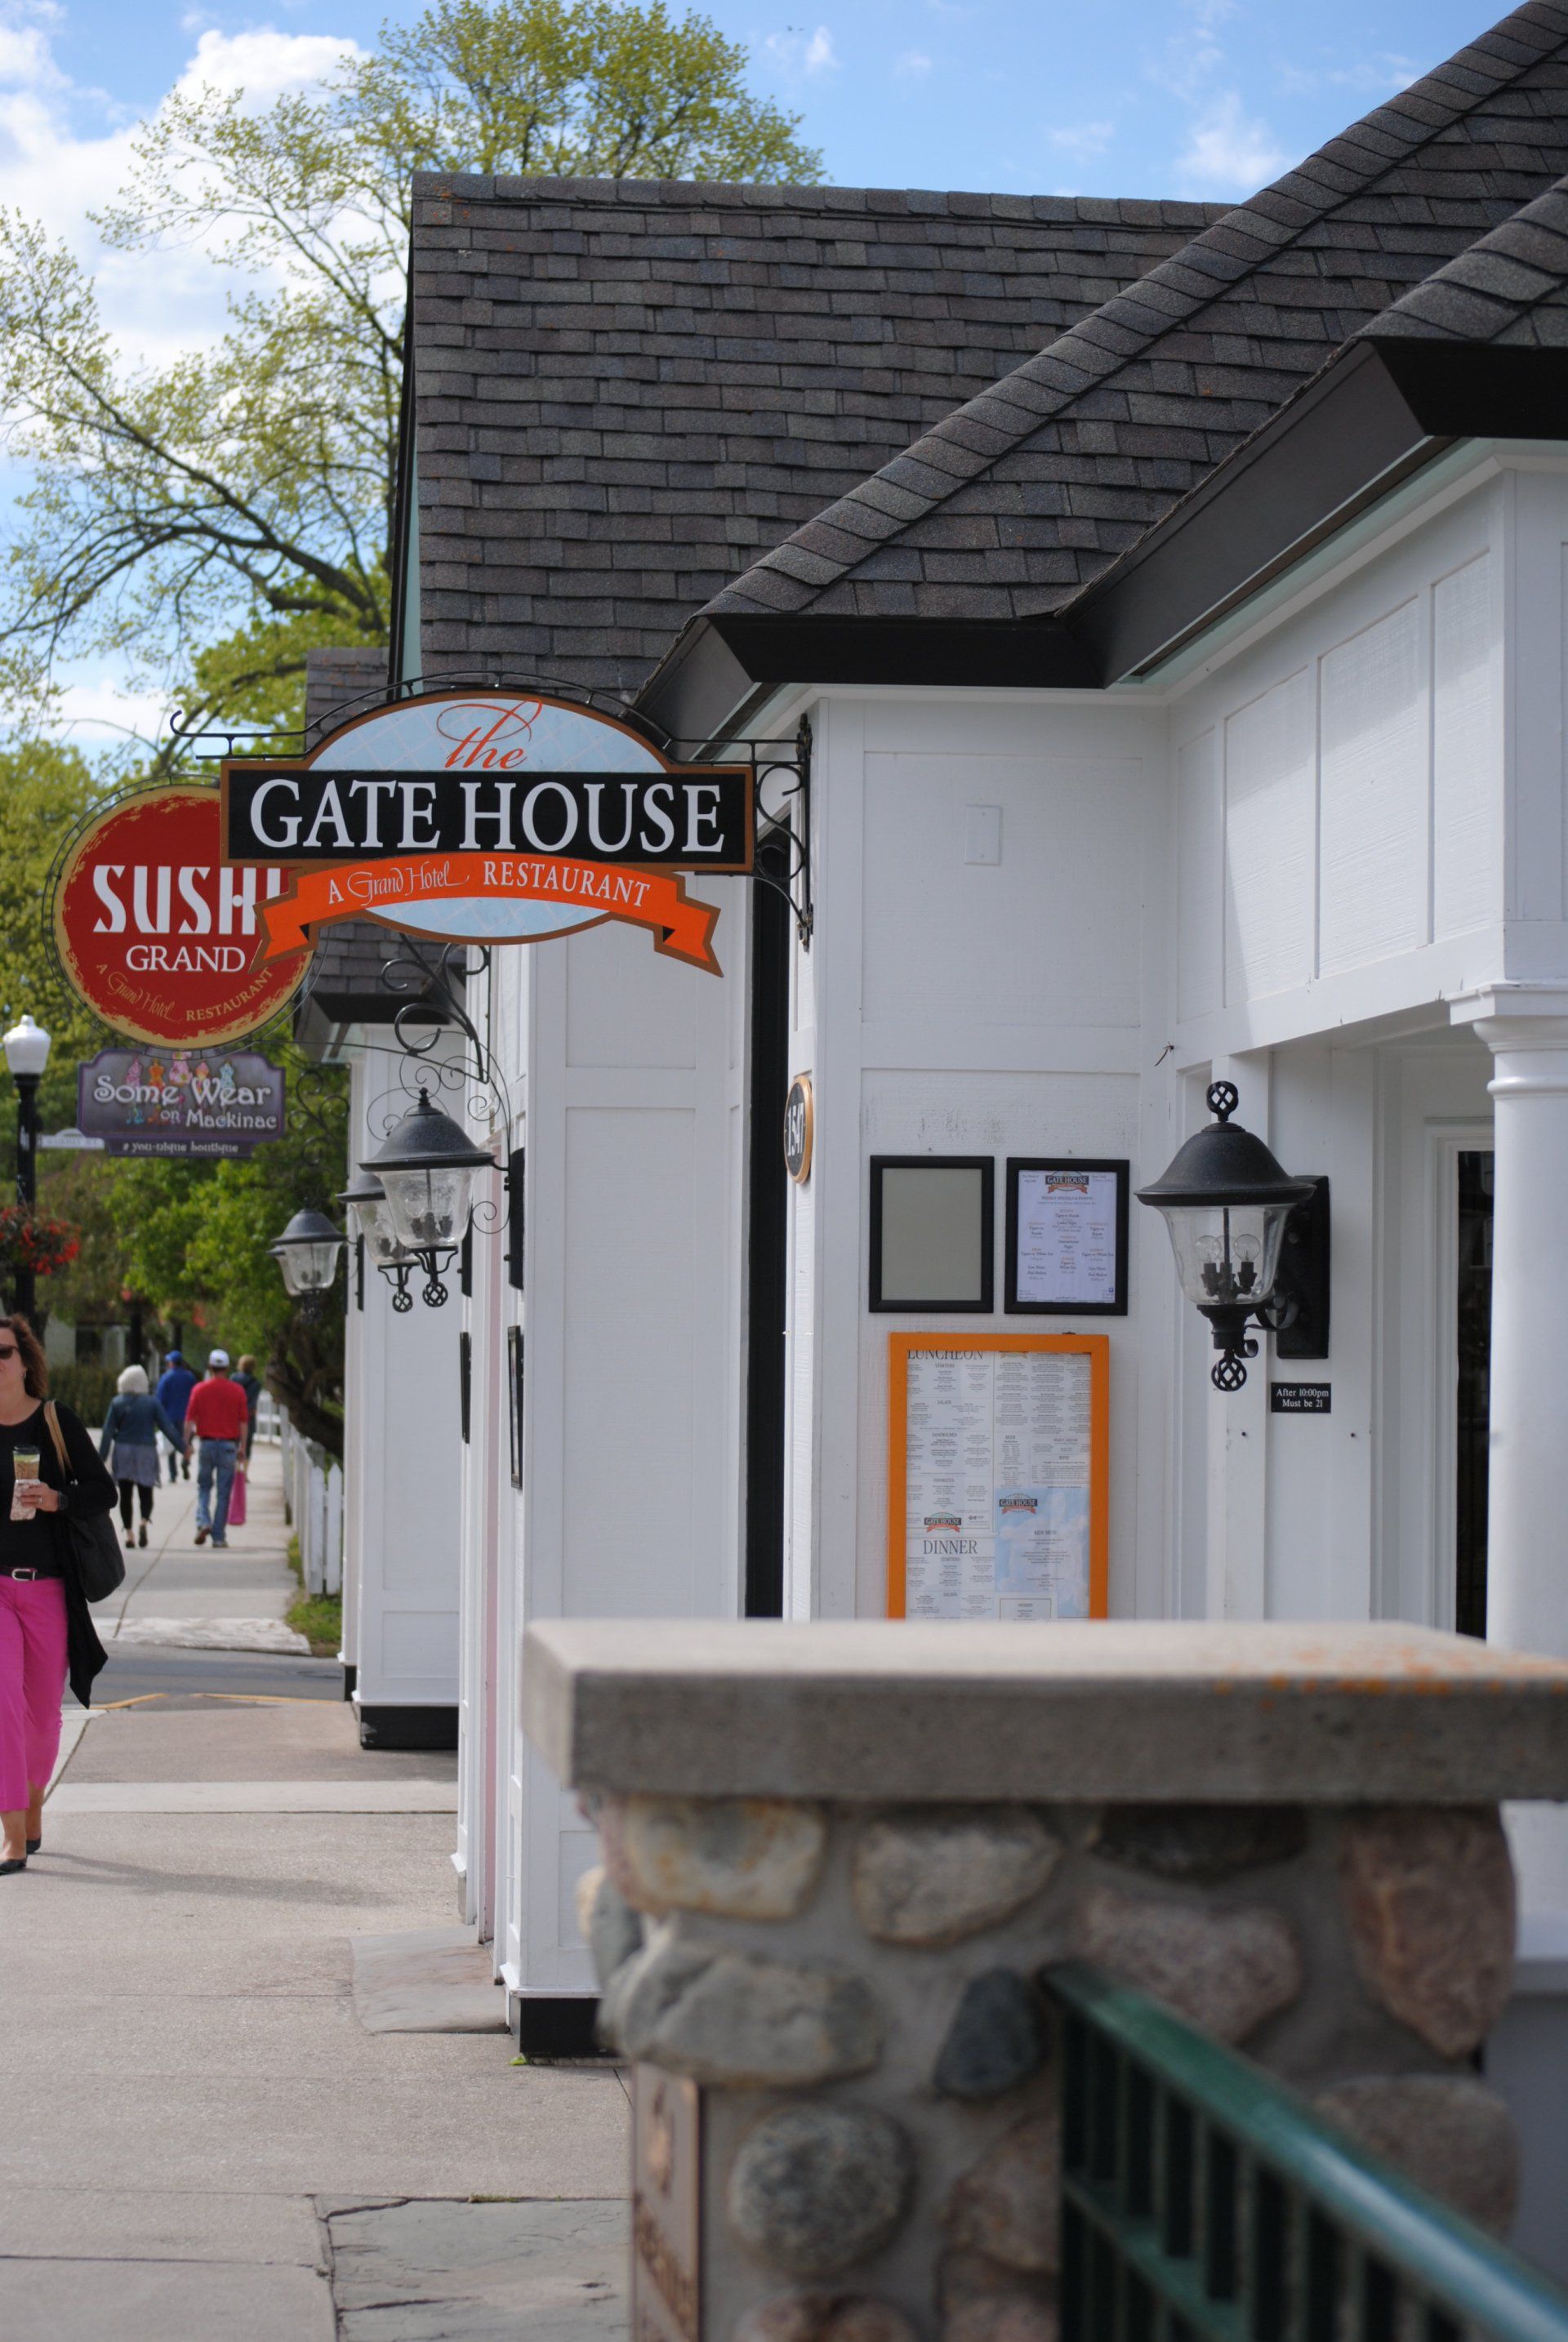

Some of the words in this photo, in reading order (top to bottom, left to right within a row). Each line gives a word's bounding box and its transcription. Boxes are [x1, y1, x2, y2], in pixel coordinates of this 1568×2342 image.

[435, 698, 543, 769] the
[250, 778, 441, 849] GATE
[458, 781, 725, 853] HOUSE
[327, 879, 344, 905] A
[347, 870, 405, 907] Grand
[403, 862, 470, 897] Hotel
[482, 861, 651, 907] RESTAURANT
[126, 944, 246, 973] GRAND
[96, 962, 108, 975] A
[107, 970, 144, 1004] Grand
[136, 991, 183, 1022] Hotel
[185, 967, 274, 1022] RESTAURANT
[93, 1075, 180, 1106] Some
[190, 1076, 272, 1106] Wear
[160, 1110, 181, 1124] on
[185, 1108, 278, 1130] Mackinac
[189, 1142, 239, 1153] boutique
[1047, 1176, 1065, 1184] GATE
[1065, 1176, 1088, 1184] HOUSE
[907, 1350, 983, 1360] LUNCHEON
[1276, 1387, 1297, 1397] After
[1298, 1388, 1330, 1398] 10:00pm
[1282, 1398, 1301, 1408] Must
[1303, 1399, 1312, 1408] be
[1316, 1399, 1323, 1408] 21
[923, 1539, 978, 1555] DINNER
